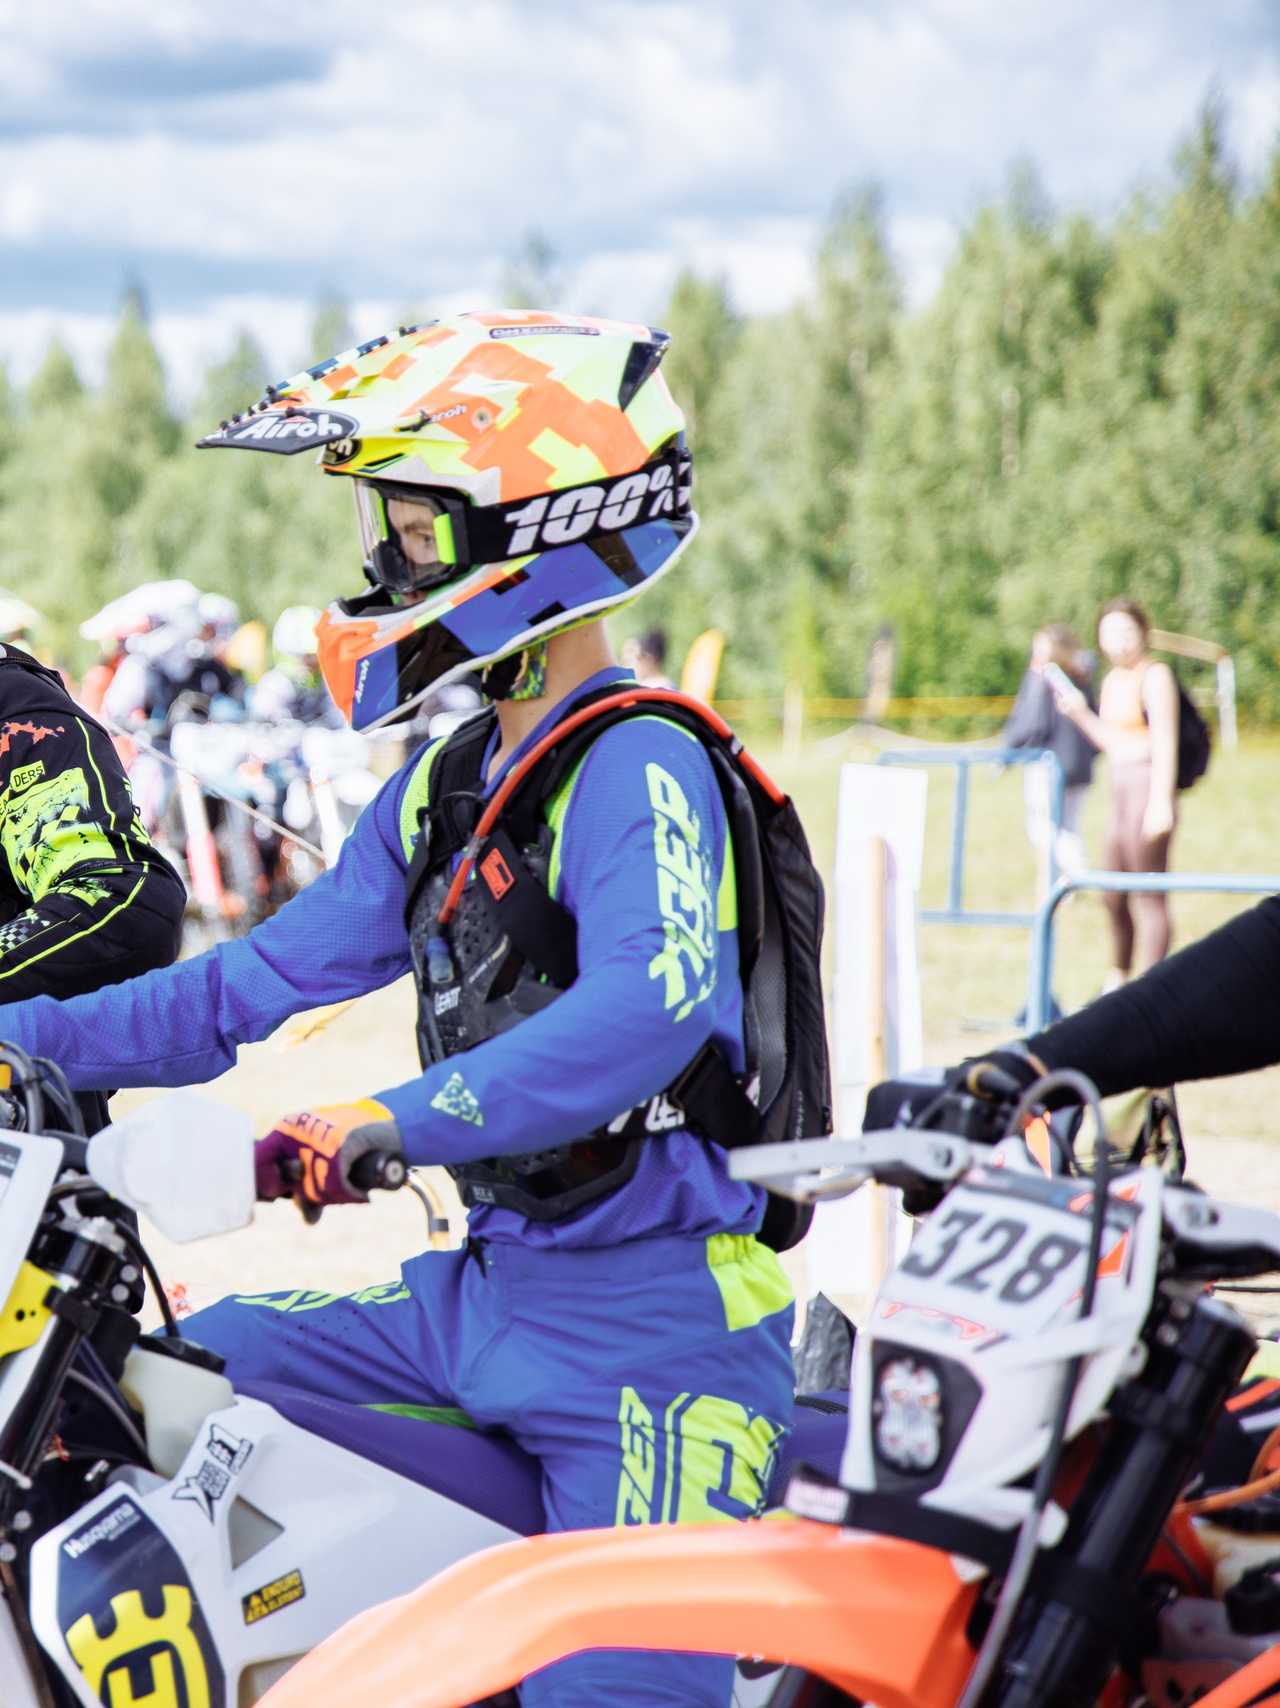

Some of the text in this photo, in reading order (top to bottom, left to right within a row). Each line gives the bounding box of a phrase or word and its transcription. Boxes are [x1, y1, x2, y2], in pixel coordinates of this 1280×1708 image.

[234, 413, 343, 440] Airoh
[504, 463, 676, 556] 100%
[285, 1112, 334, 1142] ATT
[898, 1209, 1086, 1306] 328
